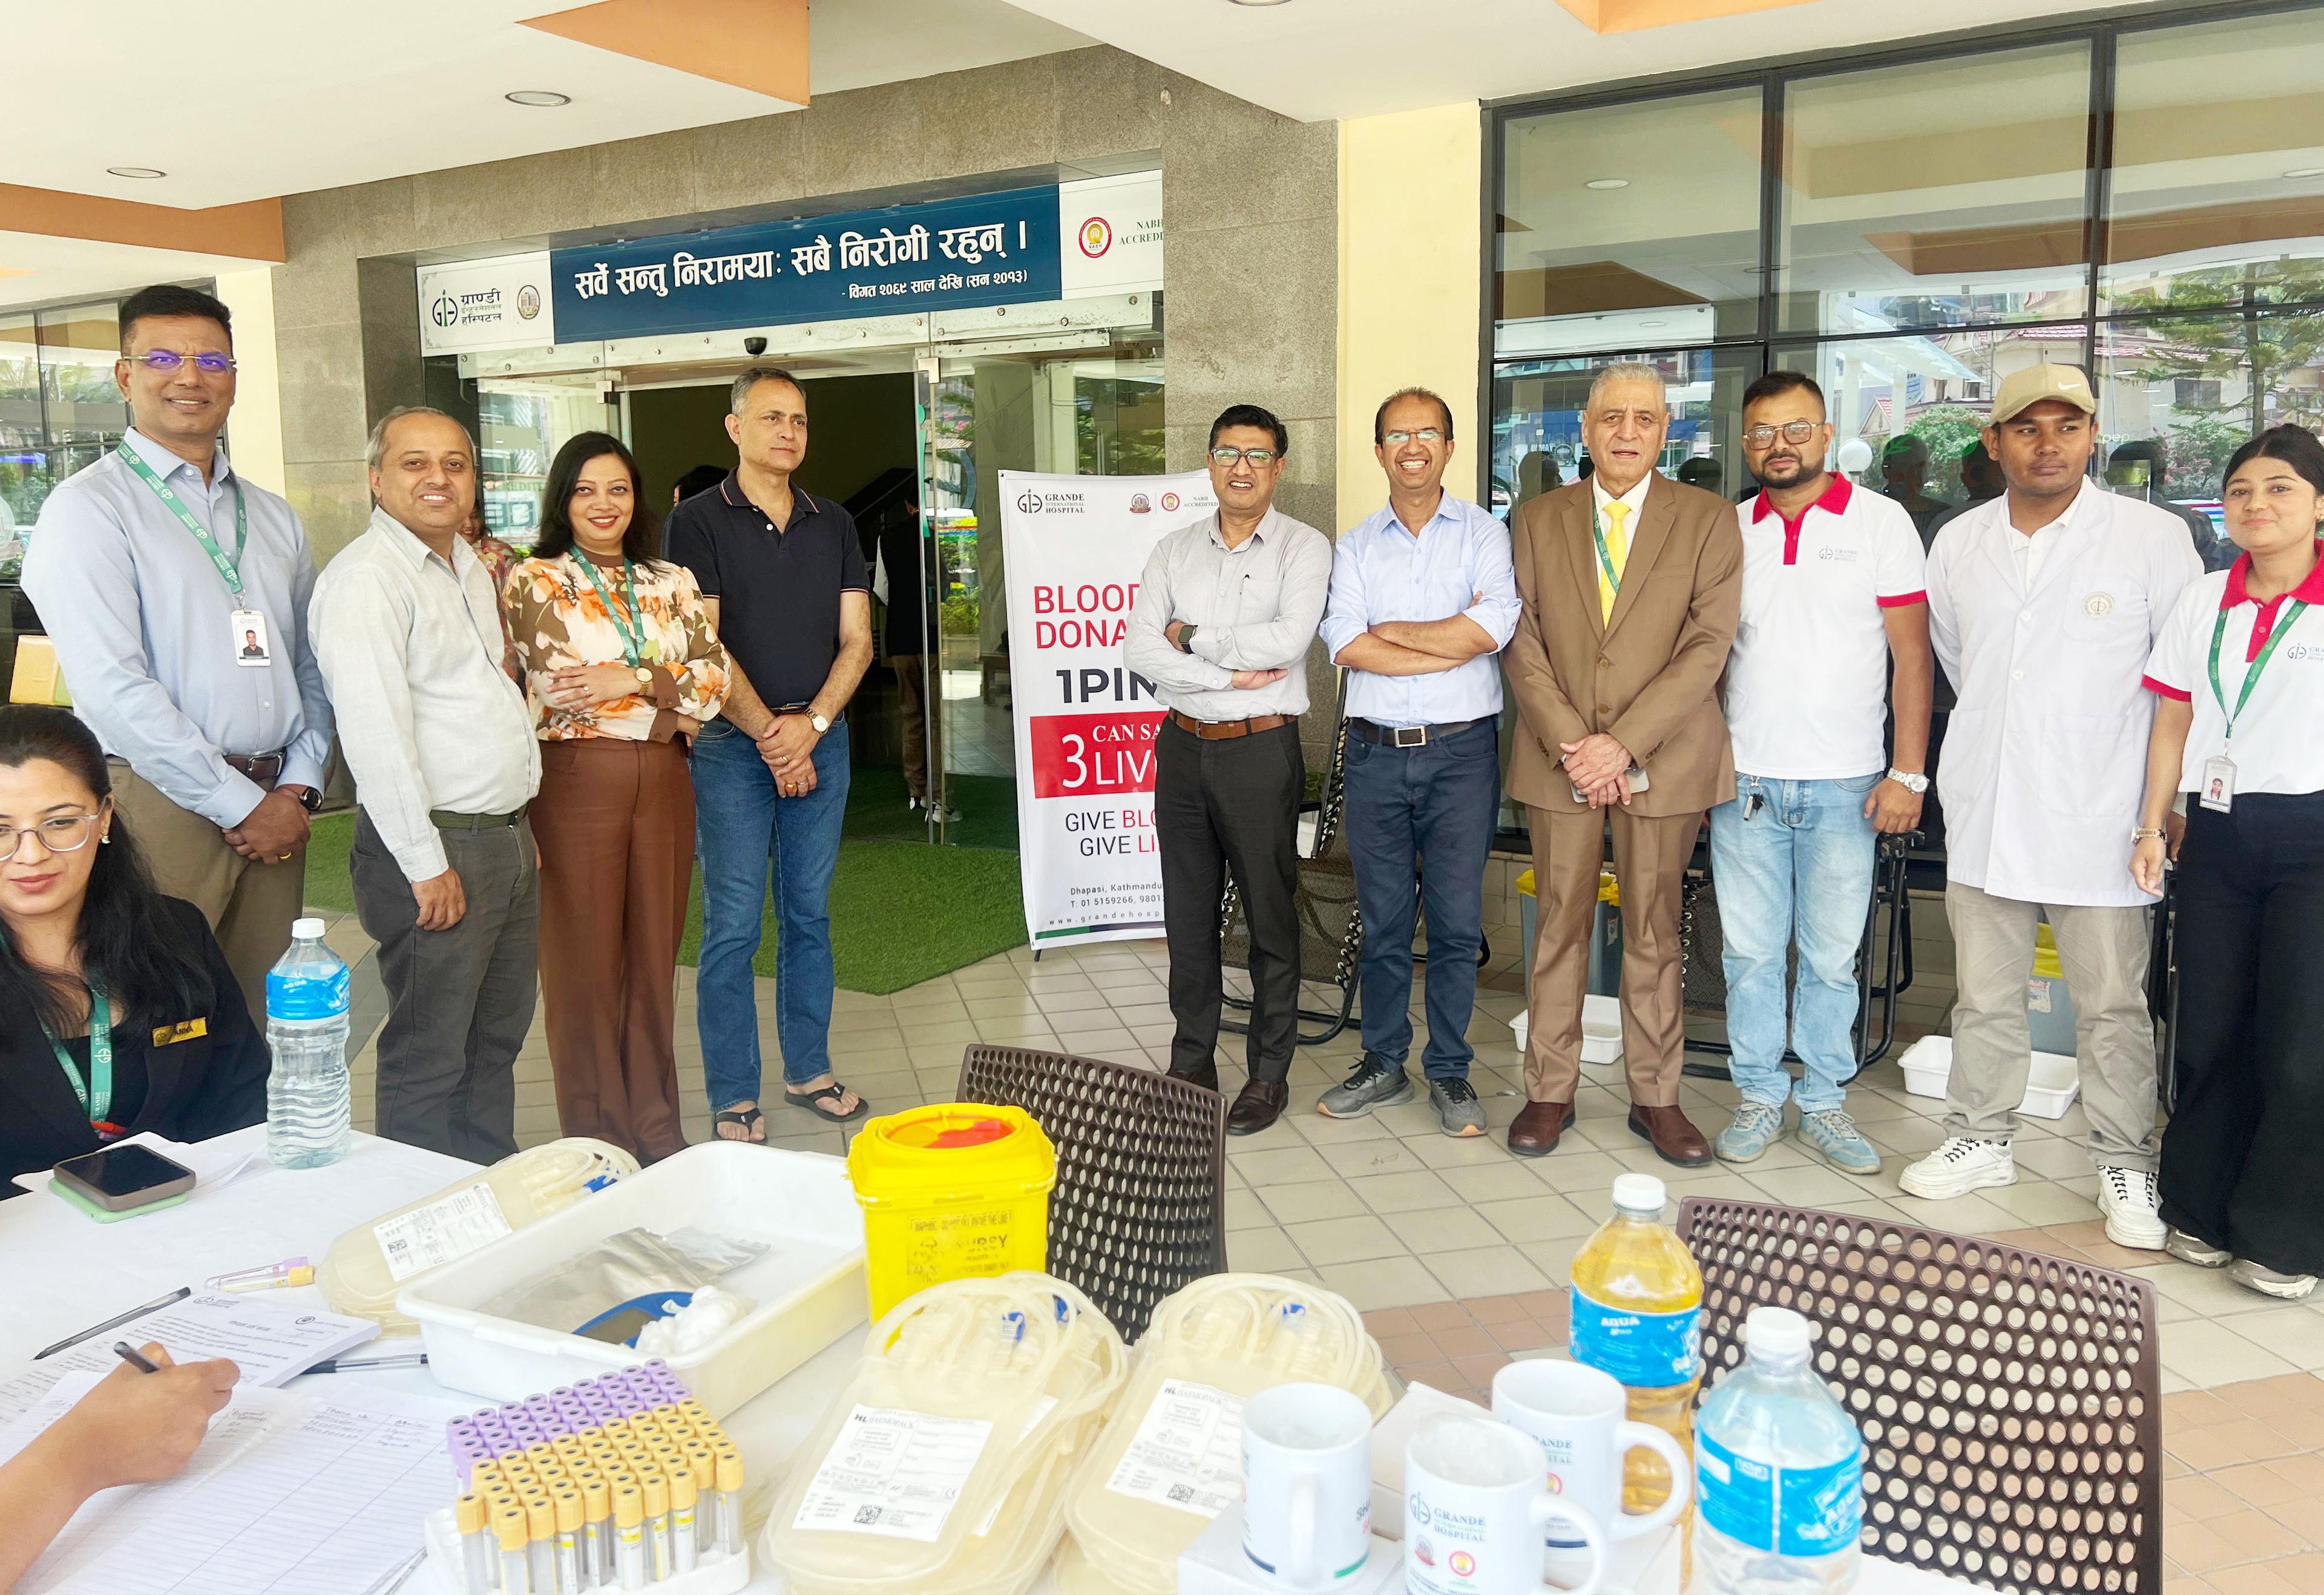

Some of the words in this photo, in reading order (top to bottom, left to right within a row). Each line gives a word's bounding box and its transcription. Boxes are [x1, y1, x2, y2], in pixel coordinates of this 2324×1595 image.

[615, 263, 669, 297] सन्तु
[790, 235, 832, 276] सबै
[839, 224, 930, 269] निरोगी
[910, 278, 936, 294] साल
[938, 272, 963, 290] देखि
[1056, 668, 1158, 703] 1PIN
[1092, 725, 1134, 743] CAN
[1062, 734, 1088, 788] 3
[1095, 749, 1157, 785] LIV
[1065, 811, 1115, 831] GIVE
[1080, 836, 1131, 856] GIVE
[1138, 834, 1160, 853] LI
[1071, 885, 1107, 895] Dhapasi,
[1111, 882, 1162, 891] Kathmandu
[1434, 1507, 1486, 1526] GRANDE
[1434, 1524, 1486, 1542] HOSPITAL
